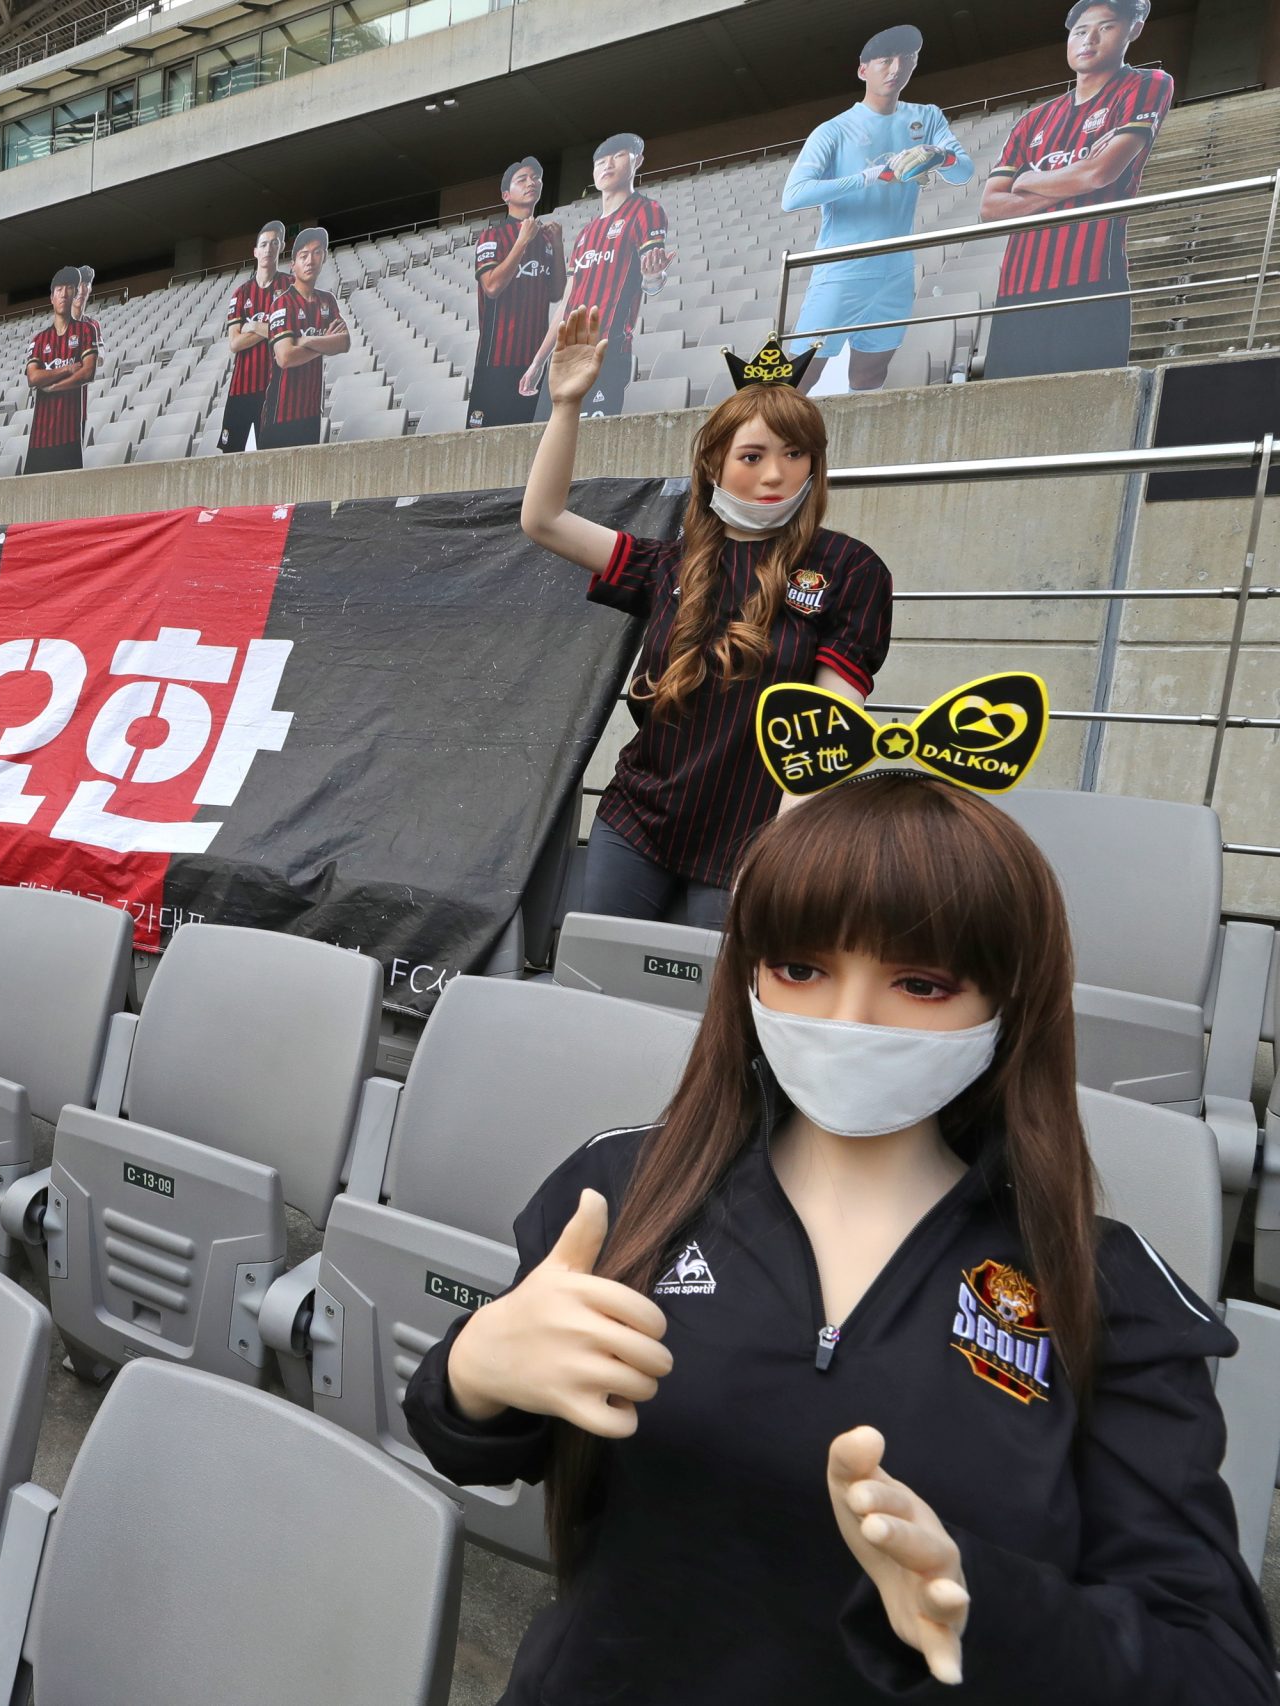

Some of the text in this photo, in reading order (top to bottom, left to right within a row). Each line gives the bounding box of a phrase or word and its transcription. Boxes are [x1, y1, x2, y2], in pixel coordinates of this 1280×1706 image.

[477, 251, 495, 262] GS25
[787, 583, 824, 608] eoul
[767, 705, 851, 749] QITA
[921, 743, 1019, 777] DALKOM
[664, 1286, 680, 1295] coq
[681, 1284, 716, 1295] sportif
[952, 1282, 1050, 1389] Seoul
